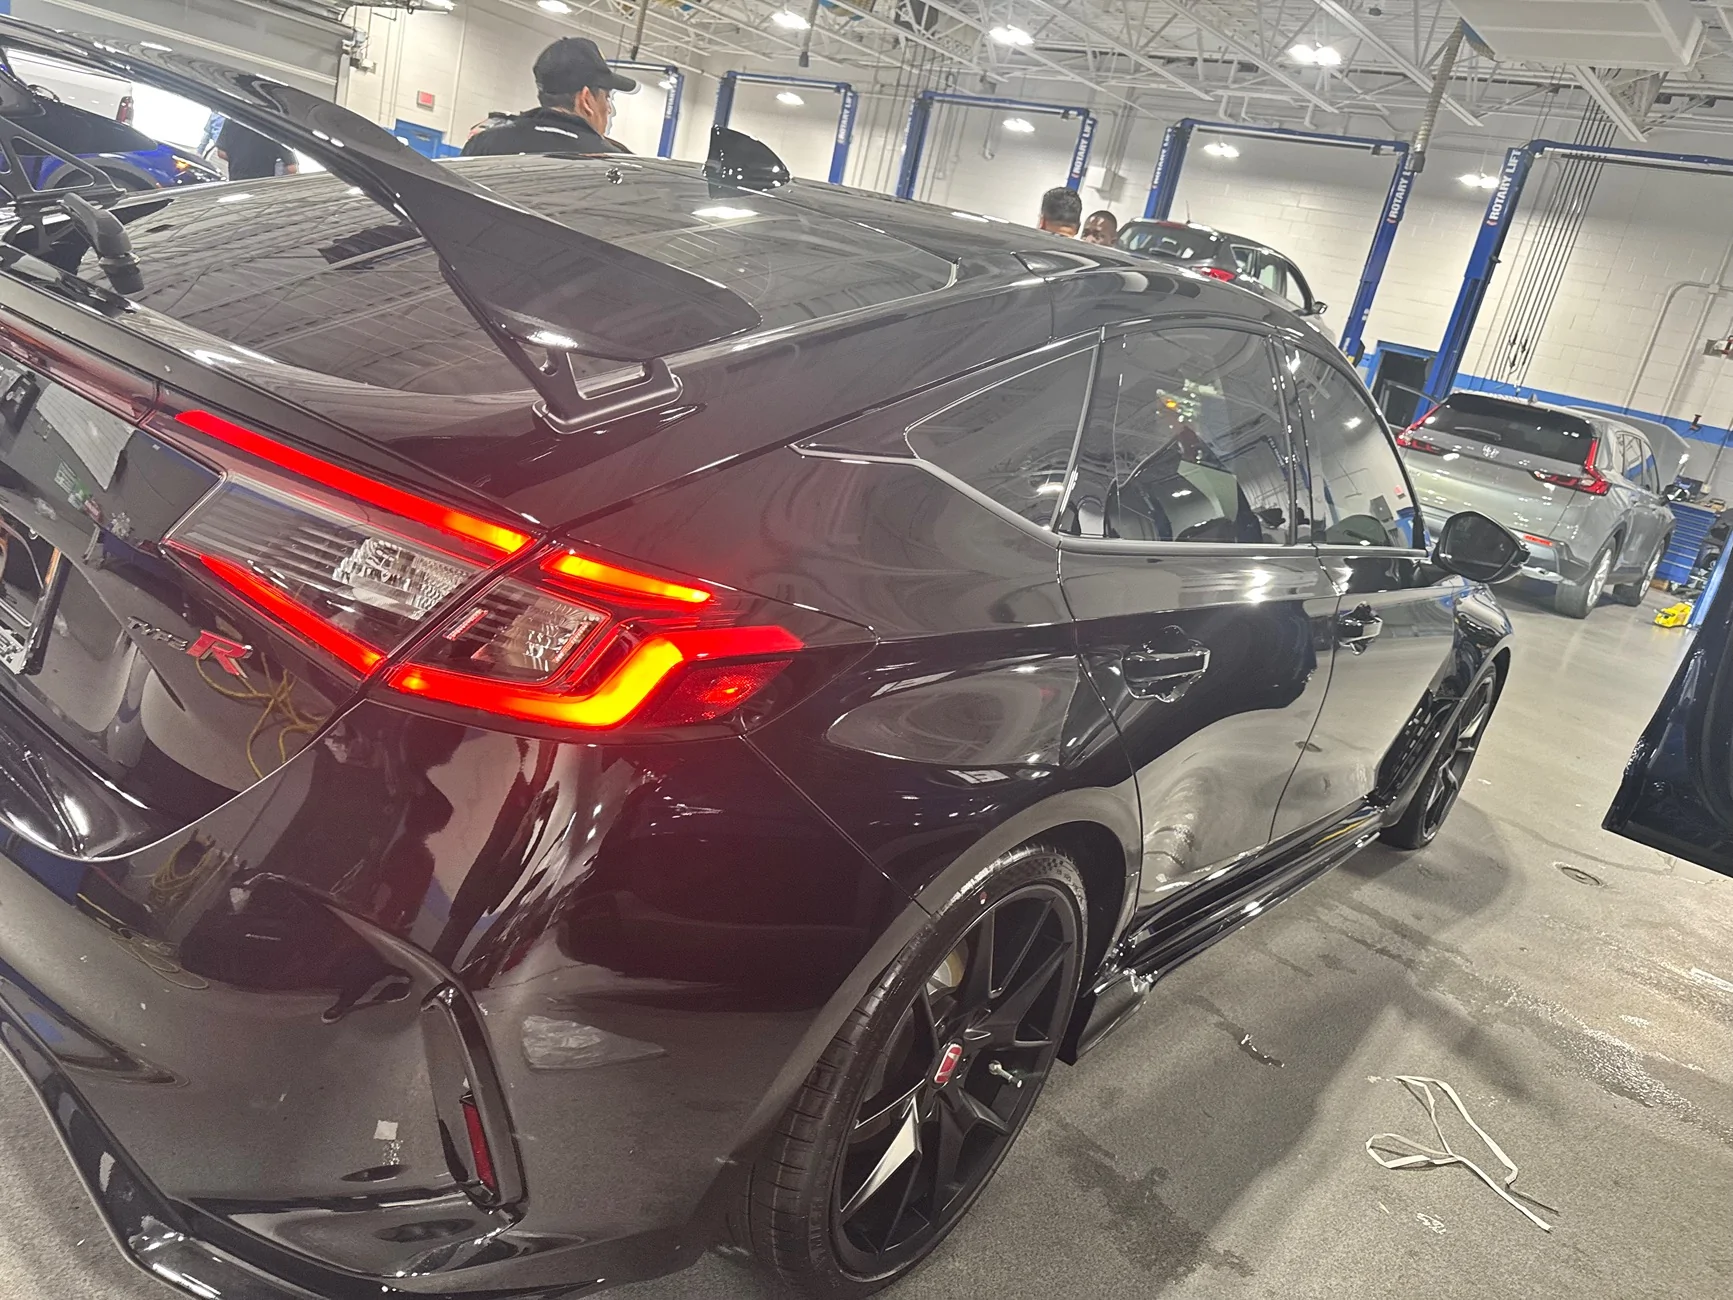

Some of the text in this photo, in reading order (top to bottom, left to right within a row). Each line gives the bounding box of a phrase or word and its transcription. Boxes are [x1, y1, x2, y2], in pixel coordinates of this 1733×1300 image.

[1072, 119, 1093, 174] ROTARY LIFT
[1389, 177, 1408, 219] ROTARY
[1489, 149, 1521, 220] ROTARY LIFT
[186, 629, 252, 678] R
